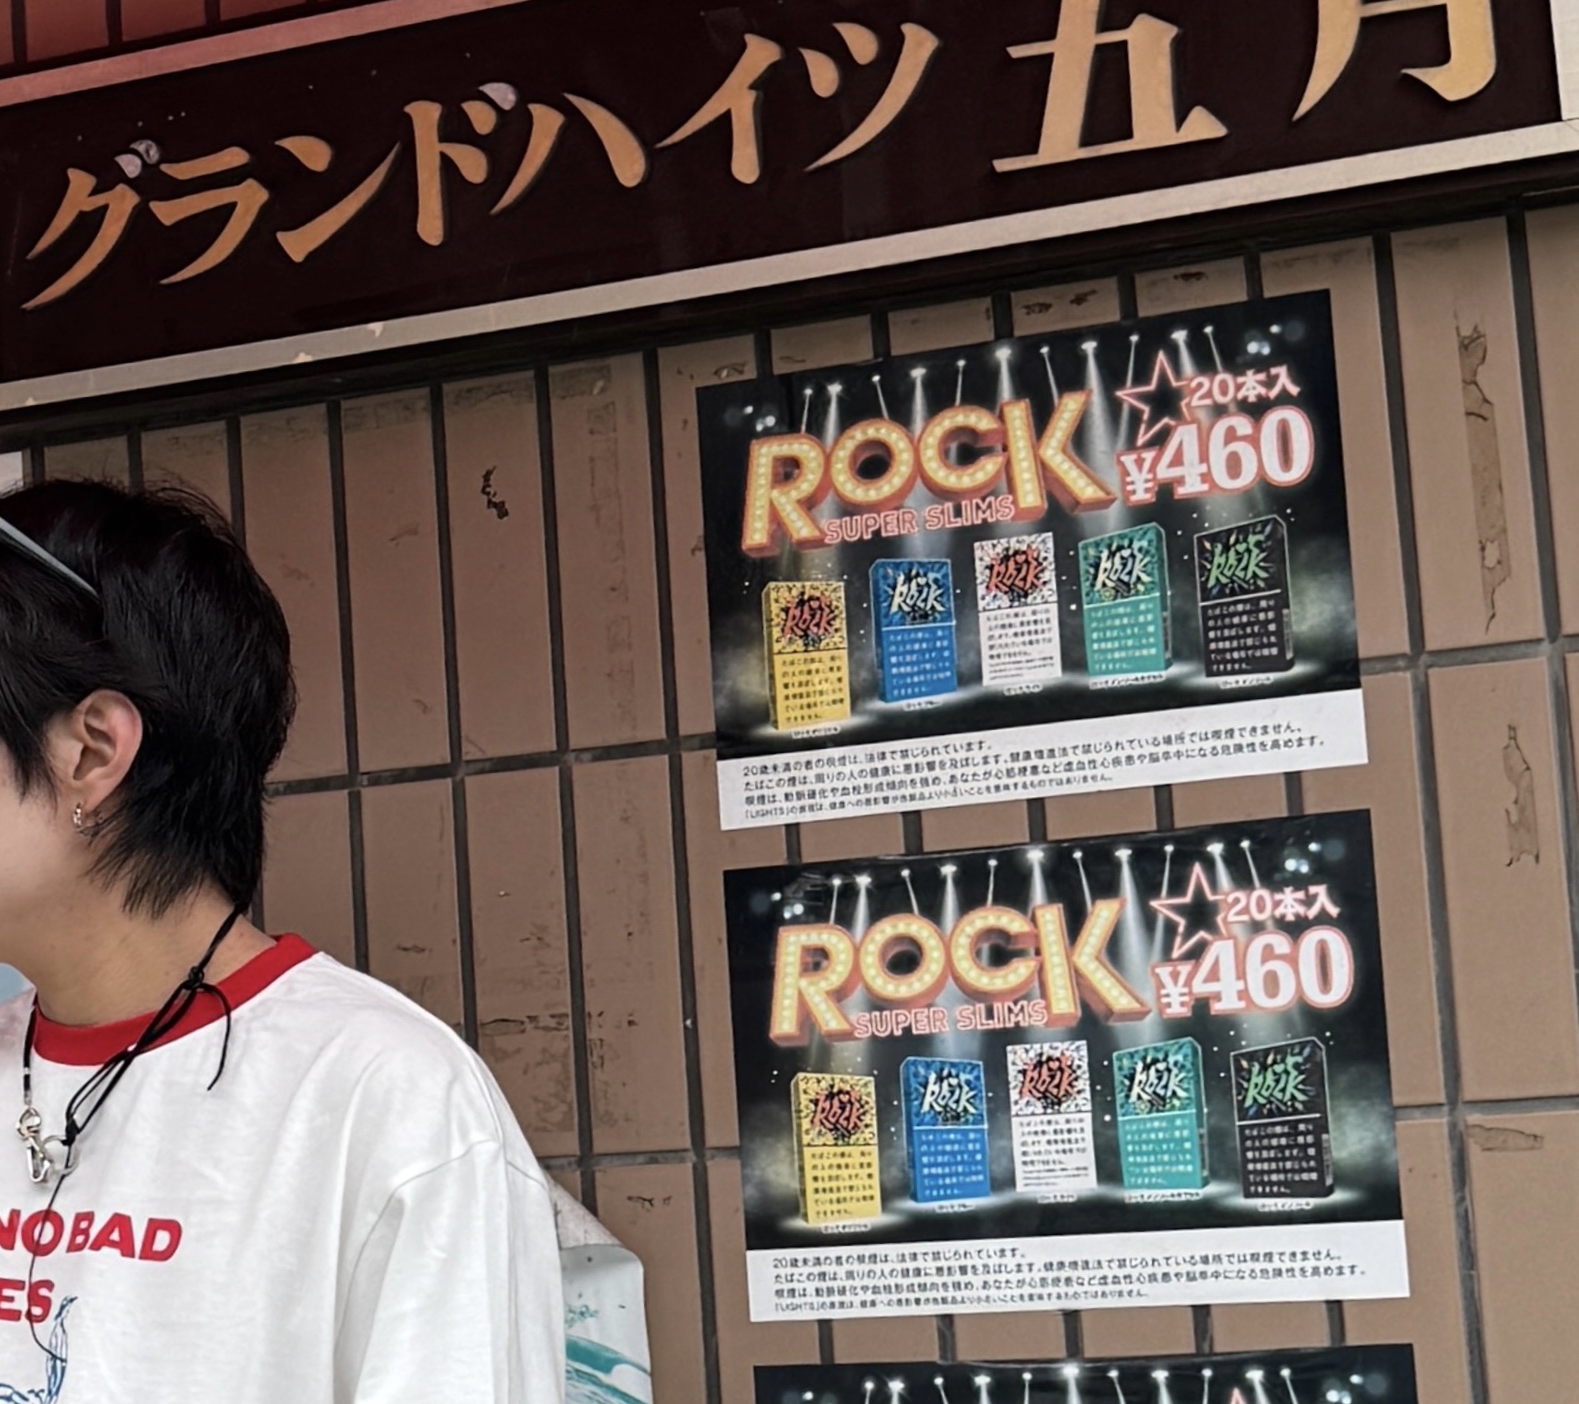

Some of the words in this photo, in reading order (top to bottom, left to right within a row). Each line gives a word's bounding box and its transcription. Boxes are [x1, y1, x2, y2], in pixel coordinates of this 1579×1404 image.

[1187, 360, 1302, 412] 20本入
[742, 388, 1115, 557] ROCK
[1118, 407, 1315, 505] ¥460
[822, 507, 918, 545] SUPER
[923, 493, 1015, 531] SLIMS
[1223, 881, 1341, 927] 20本入
[770, 897, 1150, 1046] ROCK
[1153, 928, 1354, 1018] ¥460
[851, 1006, 949, 1038] SUPER
[954, 999, 1048, 1031] SLIMS
[67, 1211, 183, 1262] BAD
